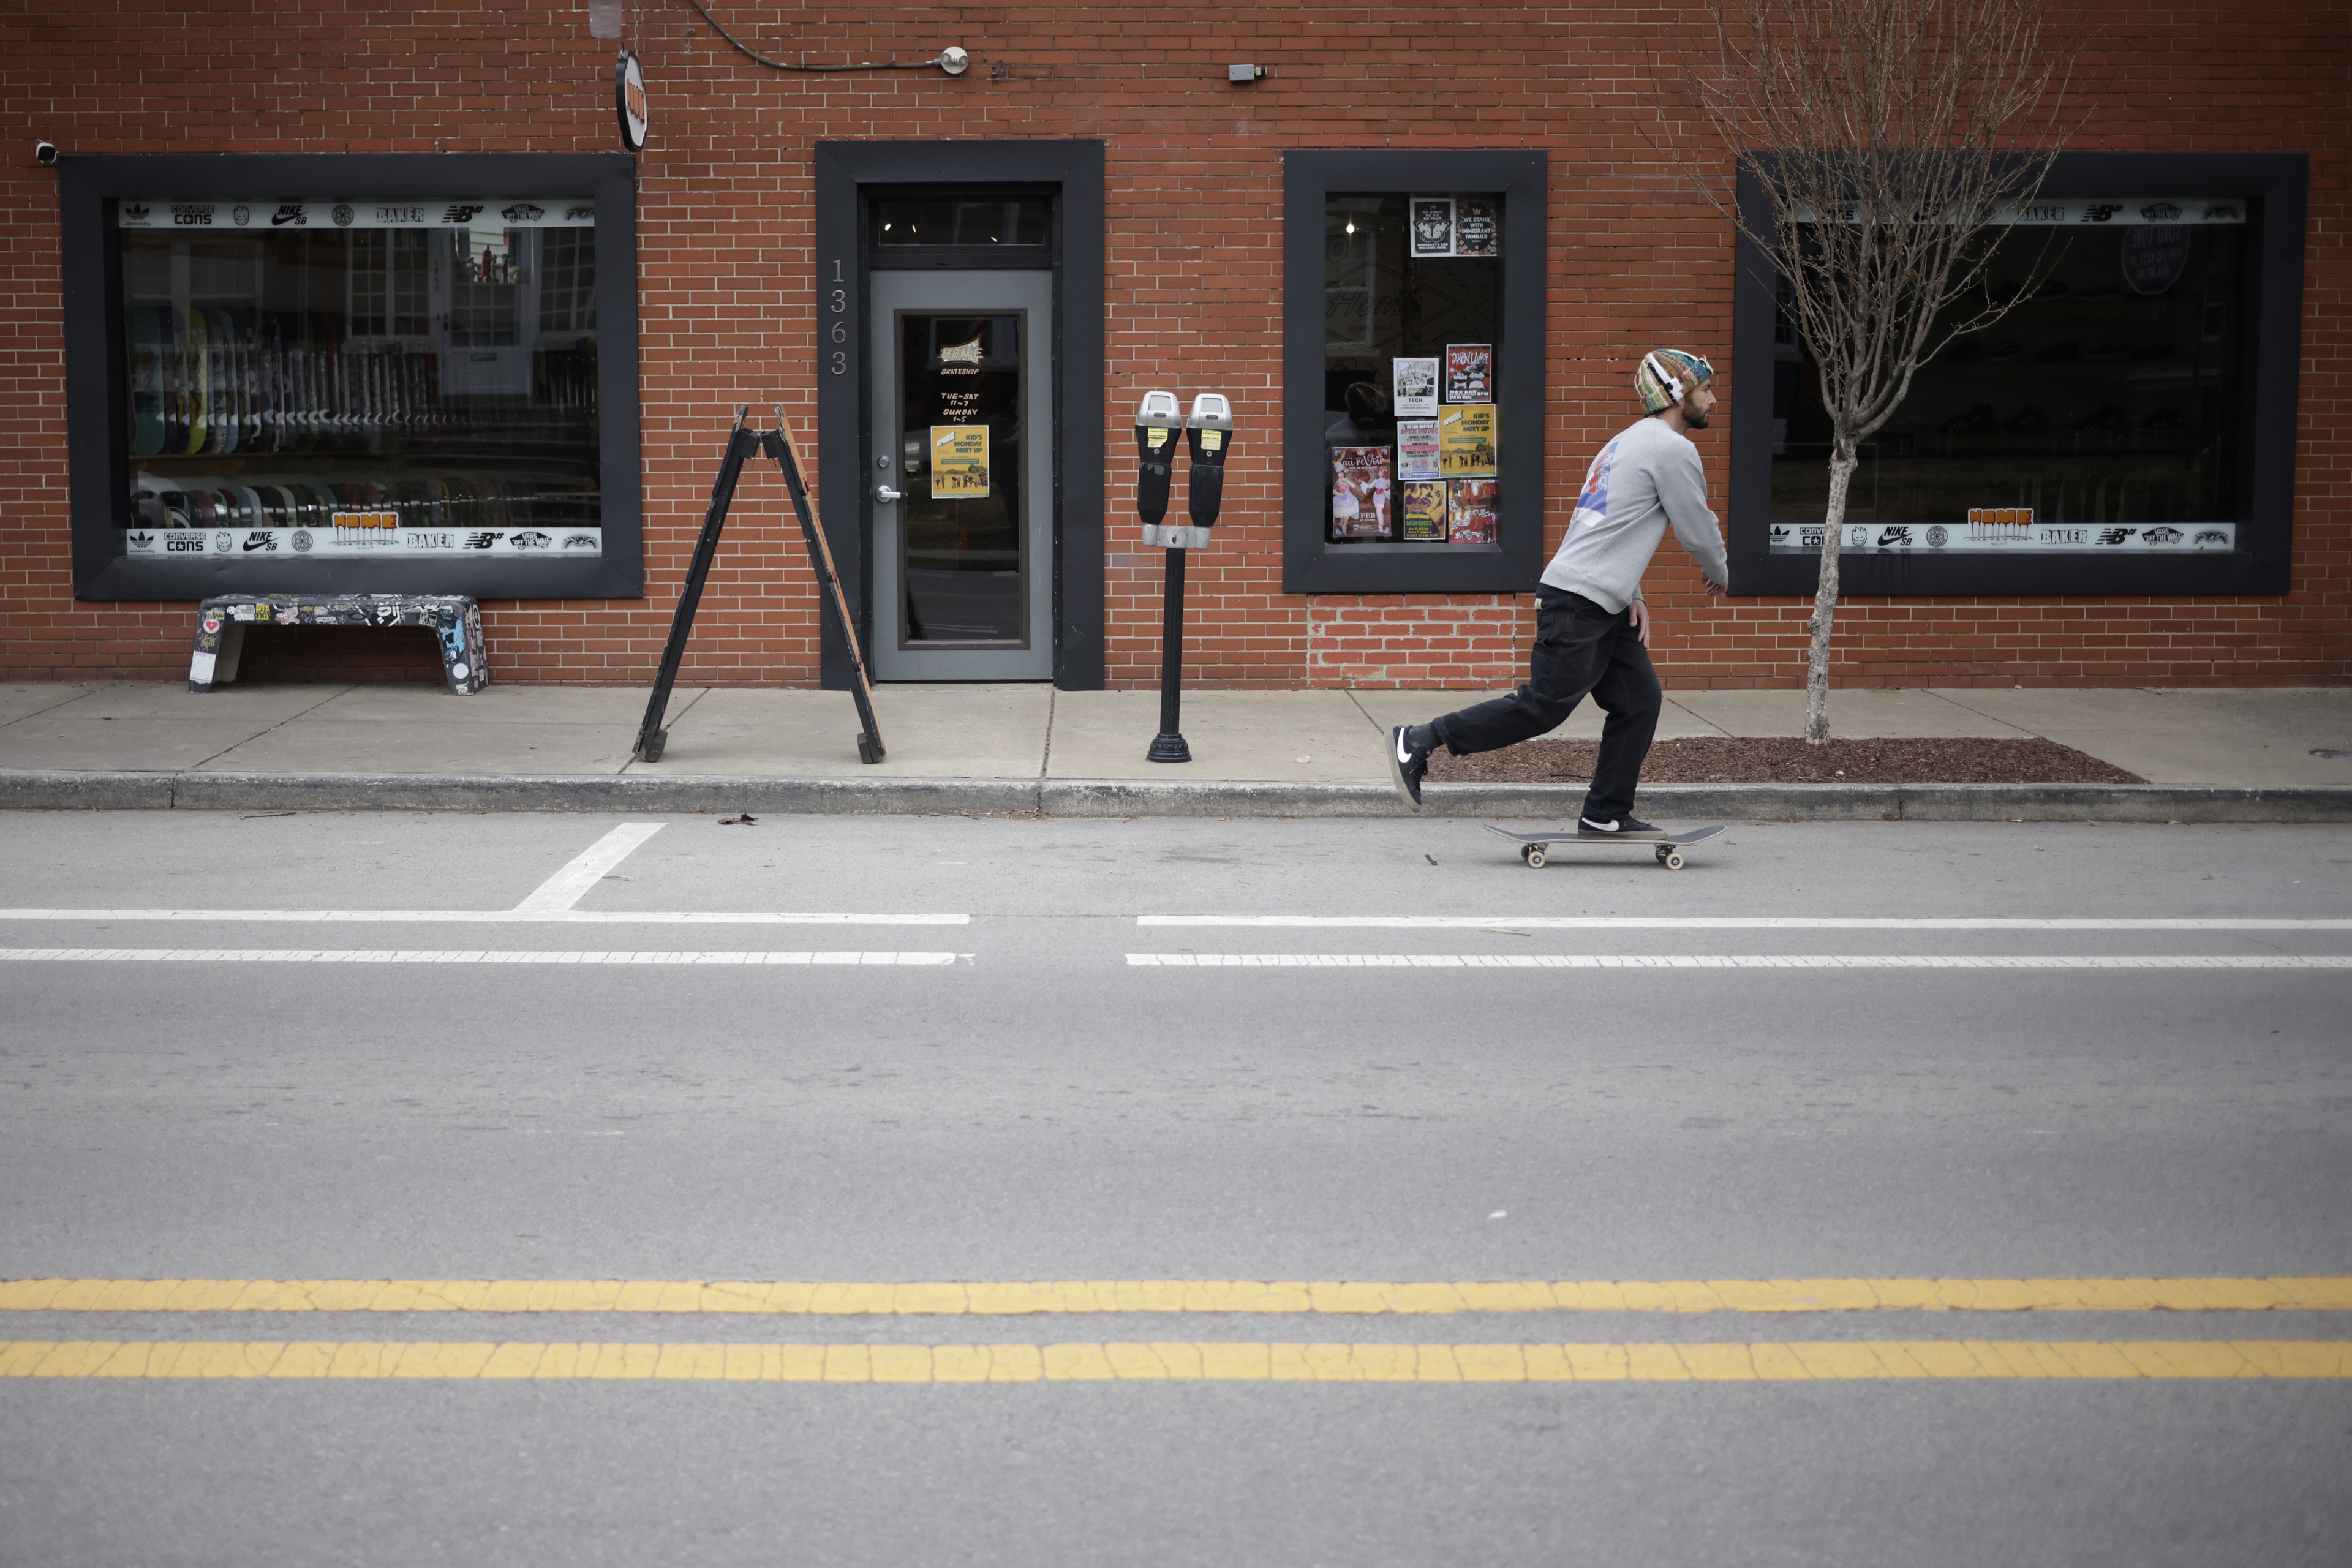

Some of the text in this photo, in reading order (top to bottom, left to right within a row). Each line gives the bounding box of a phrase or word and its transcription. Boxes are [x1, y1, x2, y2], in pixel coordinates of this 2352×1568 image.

[277, 205, 303, 215] NIKE
[377, 207, 424, 223] BAKER
[516, 211, 527, 219] THE
[2154, 210, 2166, 219] THE
[174, 214, 212, 225] CONS
[295, 216, 307, 225] SB
[831, 260, 846, 375] 1363
[940, 348, 984, 359] HOME
[334, 513, 398, 529] HOME
[1970, 510, 2032, 525] HOME
[249, 532, 273, 541] NIKE
[1884, 527, 1909, 536] NIKE
[2041, 529, 2087, 544] BAKER
[167, 541, 203, 551] CONS
[407, 533, 454, 549] BAKER
